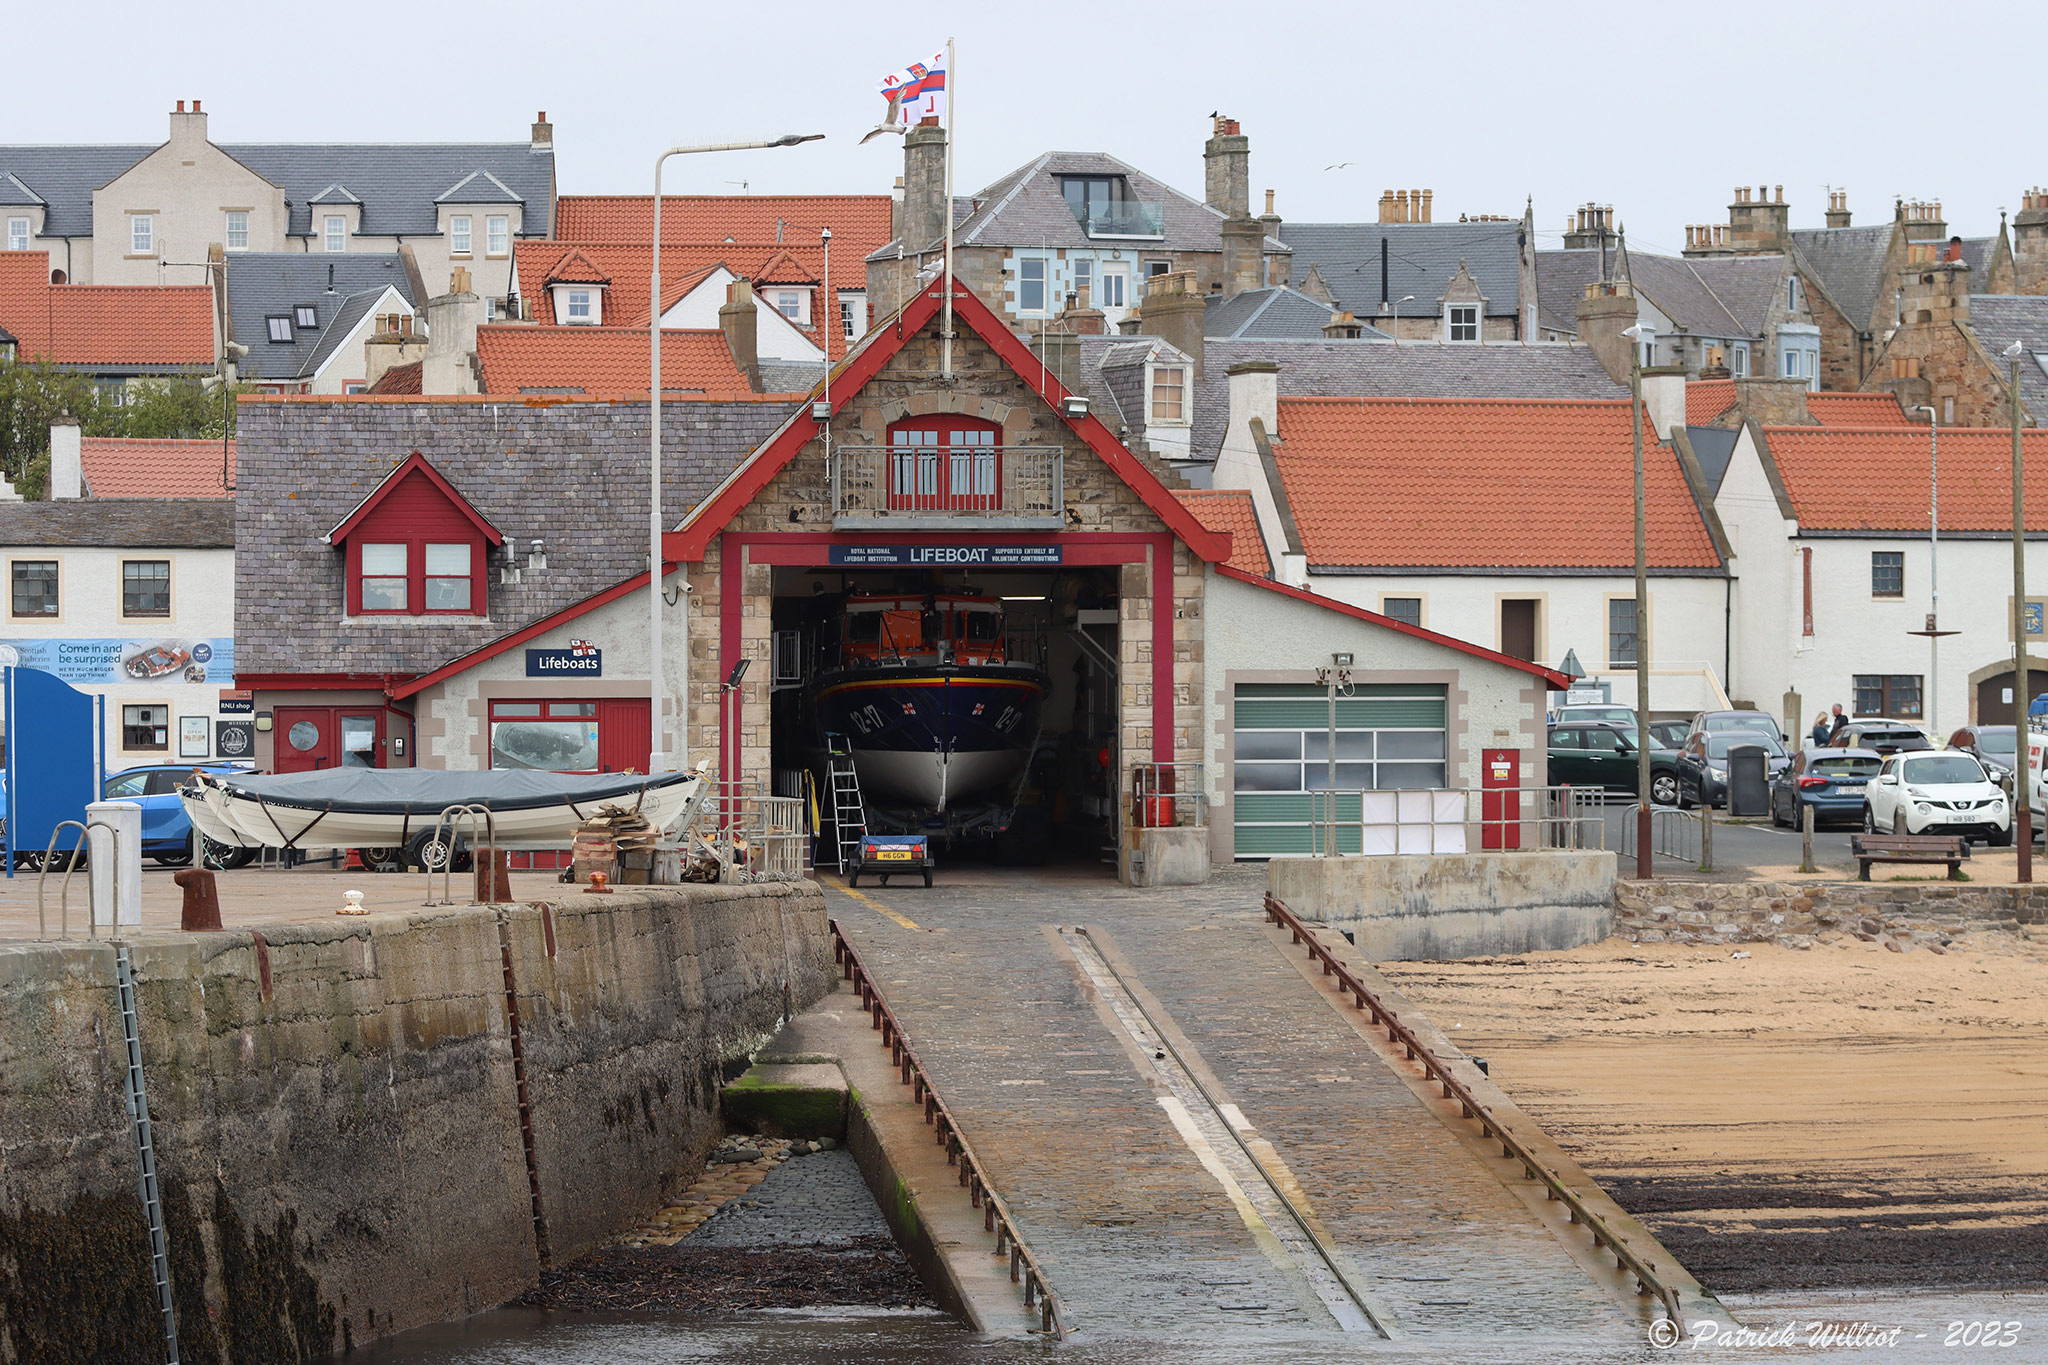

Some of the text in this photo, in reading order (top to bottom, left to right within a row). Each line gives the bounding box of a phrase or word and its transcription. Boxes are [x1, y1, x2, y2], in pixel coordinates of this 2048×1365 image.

[910, 548, 988, 562] LIFEBOAT
[58, 643, 122, 653] Come in and
[58, 653, 121, 665] be surprised
[539, 657, 598, 669] Lifeboats
